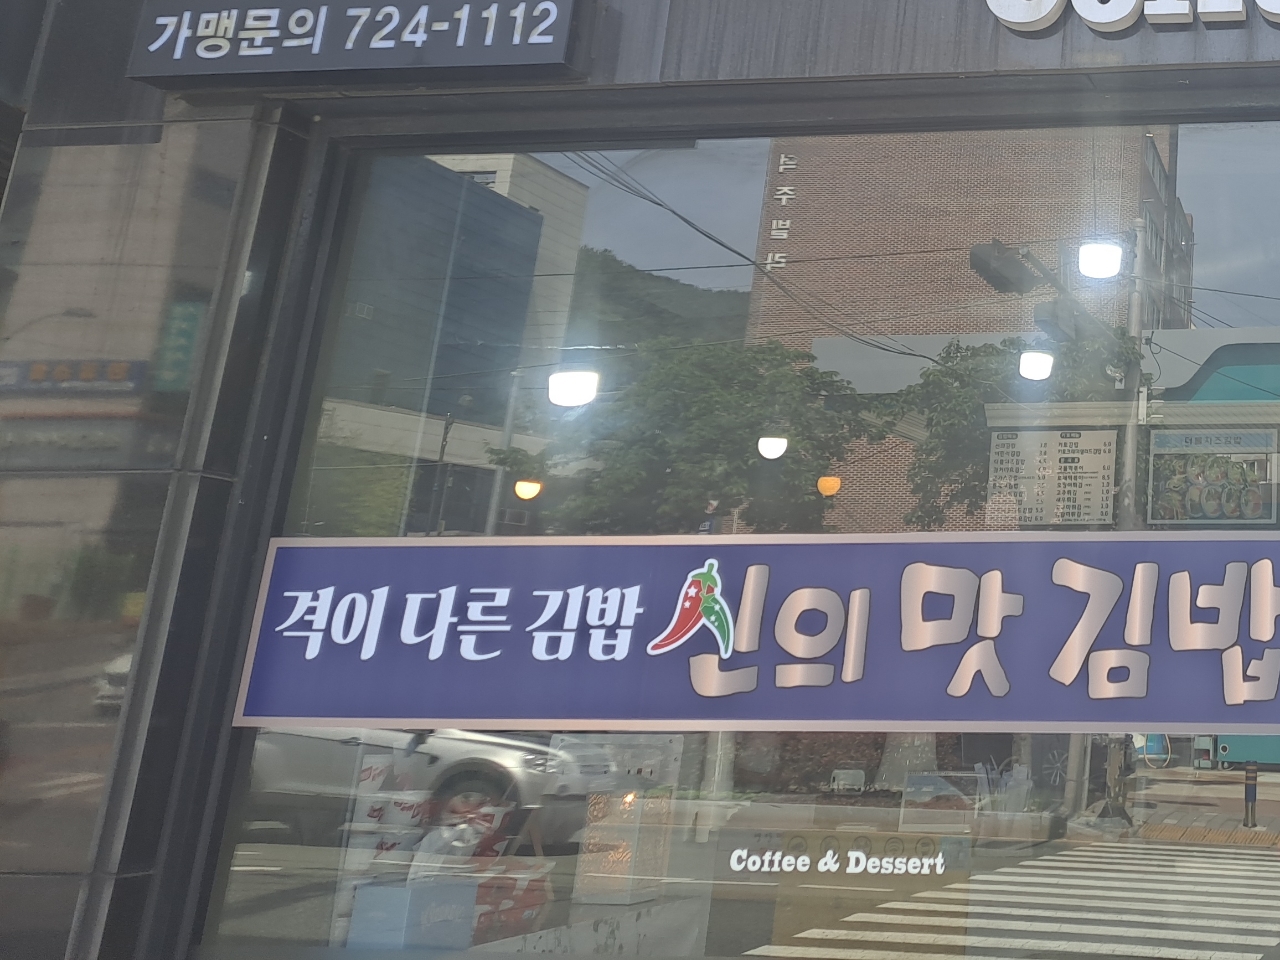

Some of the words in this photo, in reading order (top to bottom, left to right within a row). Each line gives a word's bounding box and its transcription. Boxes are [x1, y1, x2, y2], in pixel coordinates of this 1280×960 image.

[147, 4, 329, 60] 가맹문의
[344, 0, 559, 50] 724-1112
[274, 585, 390, 661] 격이
[399, 585, 512, 661] 다른
[525, 584, 645, 661] 김밥
[646, 558, 871, 698] 신의
[899, 561, 1025, 698] 맛
[729, 847, 811, 873] Coffee
[817, 849, 840, 873] &
[845, 850, 946, 876] Dessert
